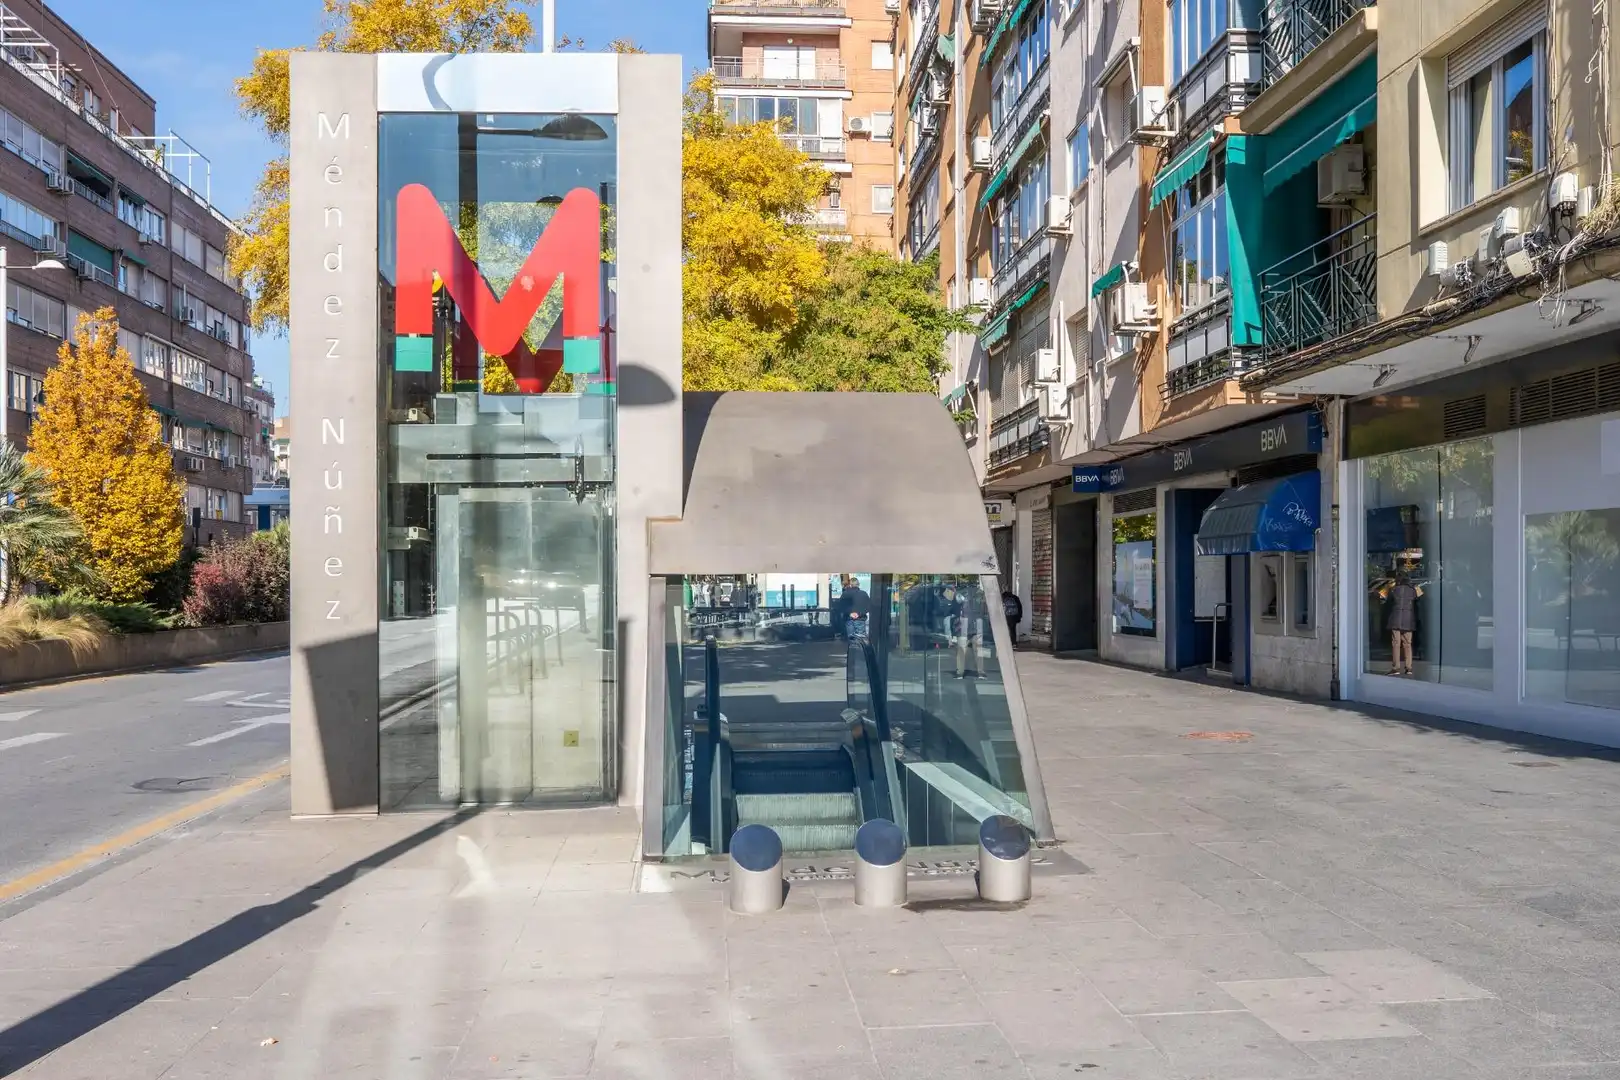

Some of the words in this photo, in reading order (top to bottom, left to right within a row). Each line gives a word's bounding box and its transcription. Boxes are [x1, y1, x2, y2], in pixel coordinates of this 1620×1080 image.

[317, 112, 350, 358] Méndez
[396, 183, 600, 373] M
[1261, 424, 1287, 452] BBVA
[1173, 447, 1193, 471] BBVA
[1075, 474, 1100, 483] BBVA
[1110, 466, 1125, 486] BBVA
[321, 417, 345, 620] Núñez
